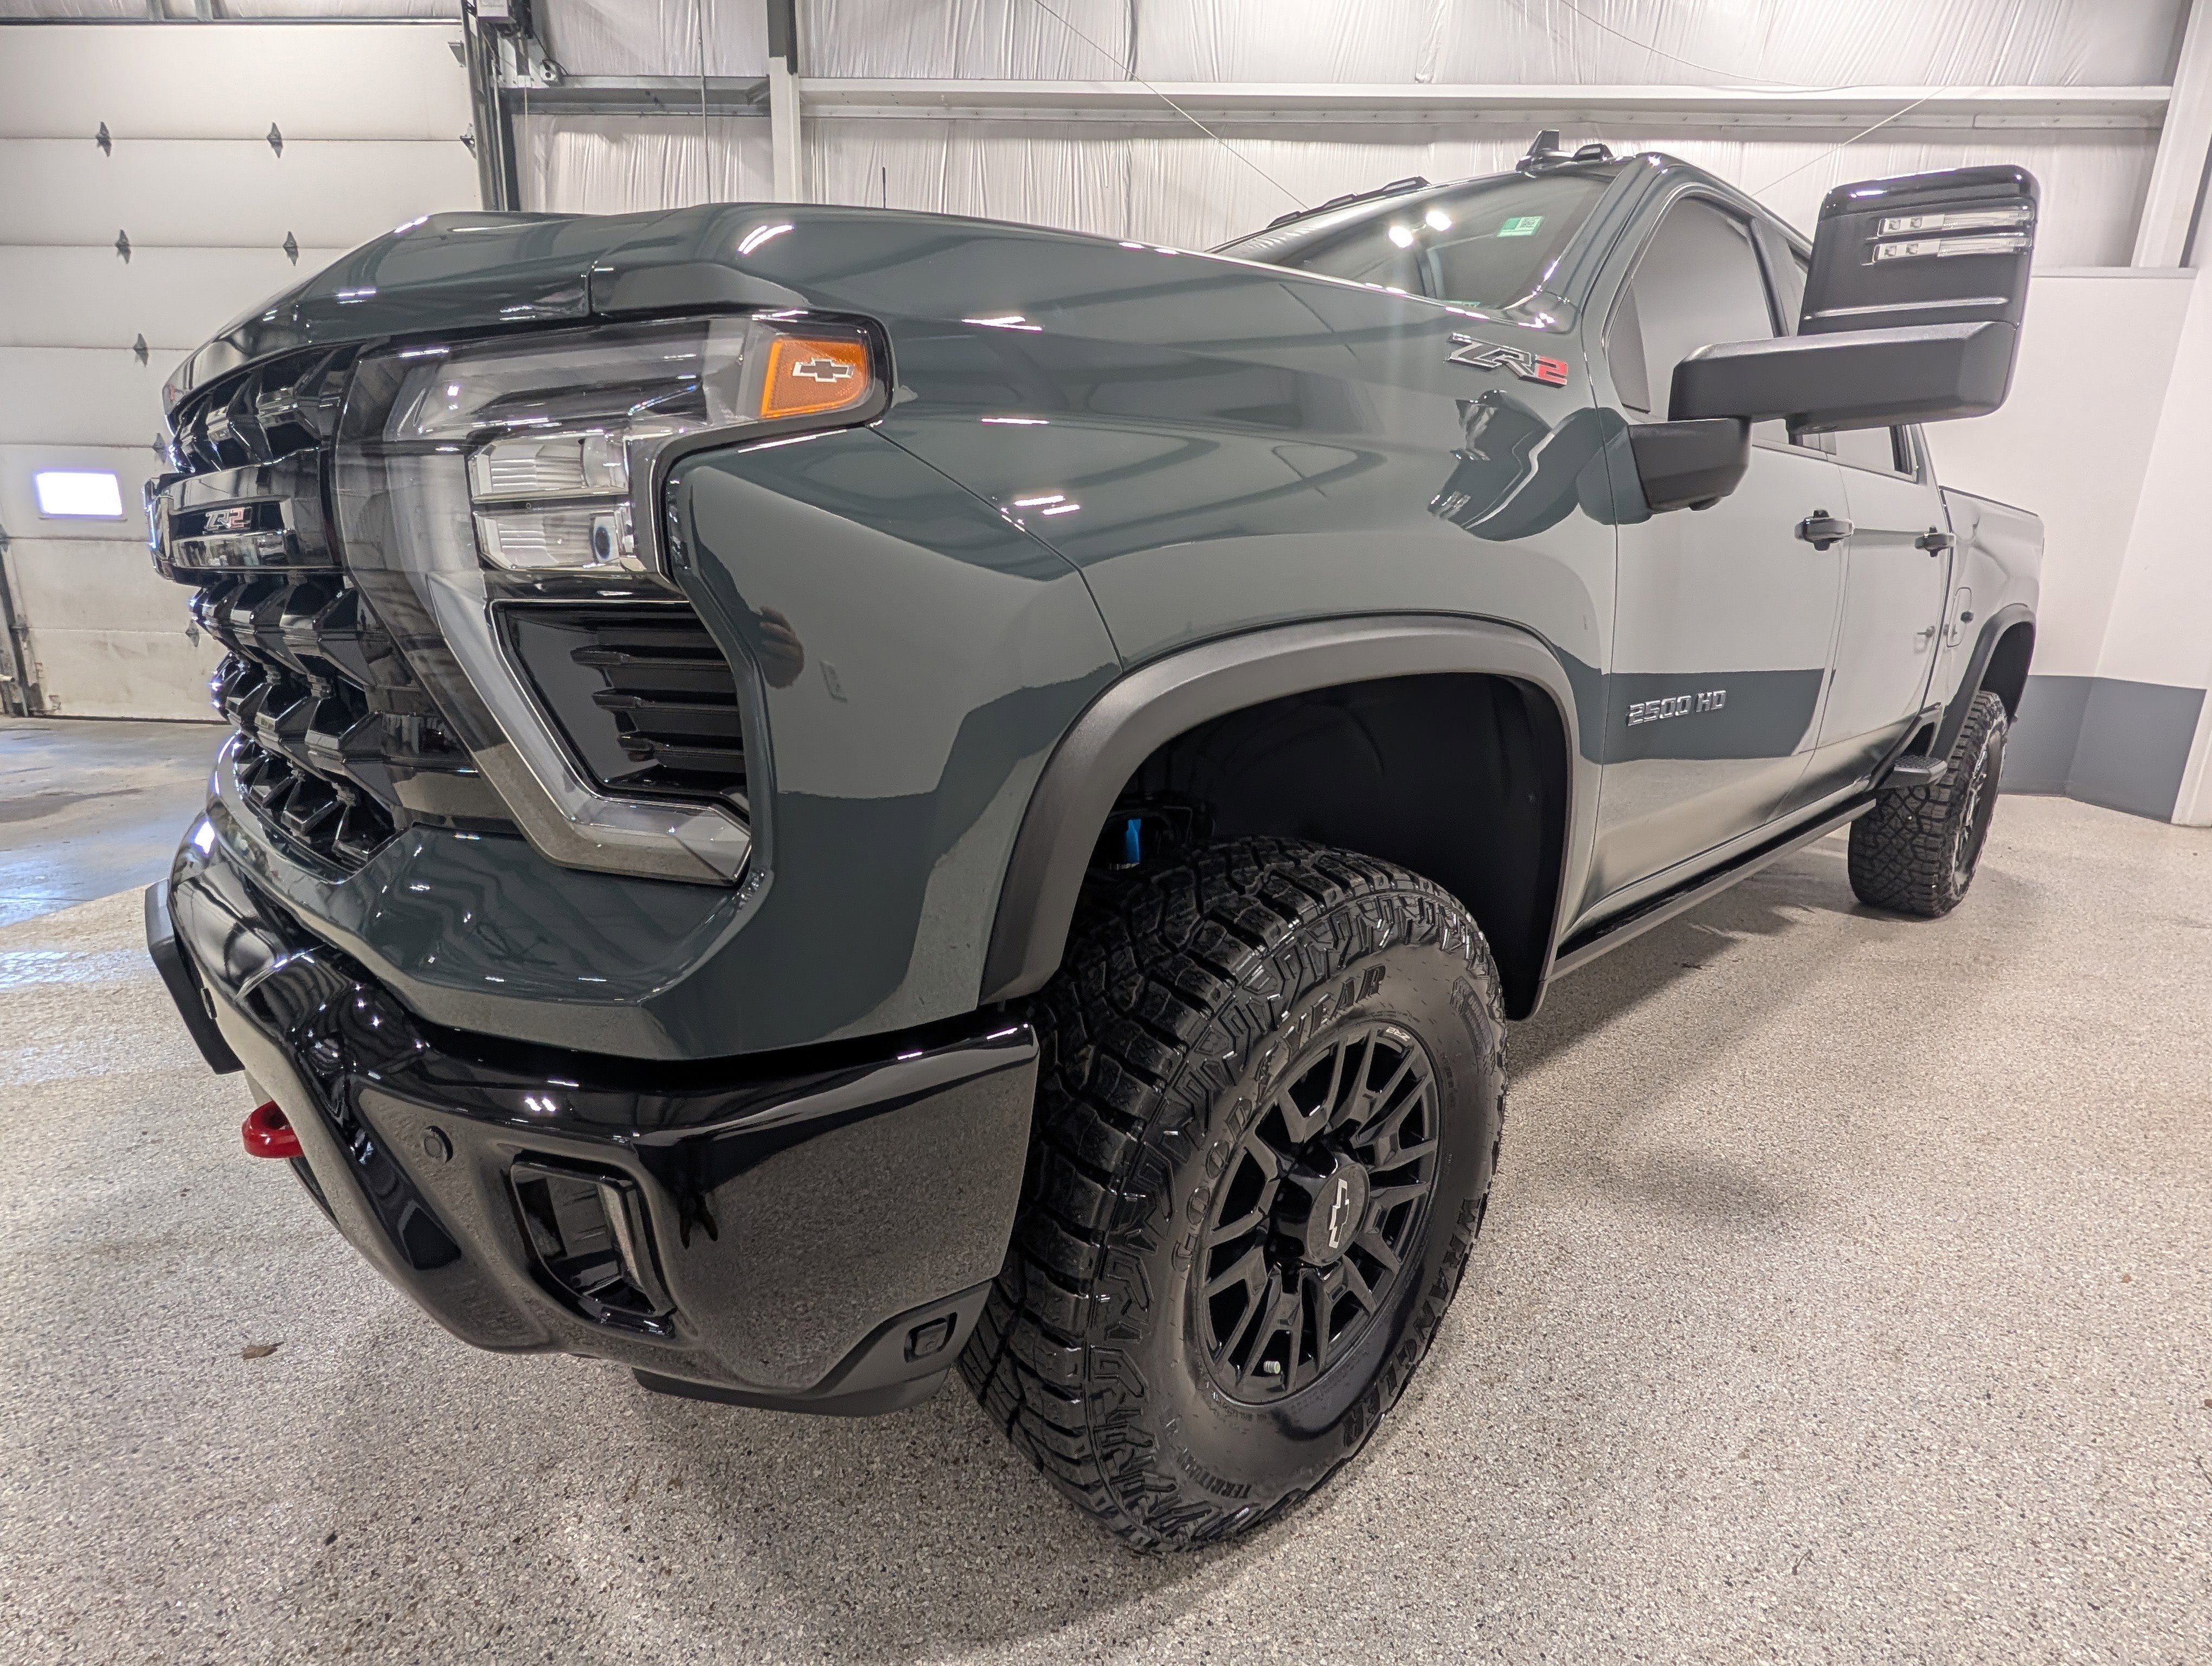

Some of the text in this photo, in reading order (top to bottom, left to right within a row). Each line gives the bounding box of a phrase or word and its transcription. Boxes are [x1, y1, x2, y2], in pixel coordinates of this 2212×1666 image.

[1444, 330, 1568, 387] ZR2
[205, 507, 246, 531] ZR2
[1627, 690, 1727, 727] 2500 HD
[1385, 1026, 1410, 1042] ZR2
[1343, 1197, 1481, 1448] WRANGLER
